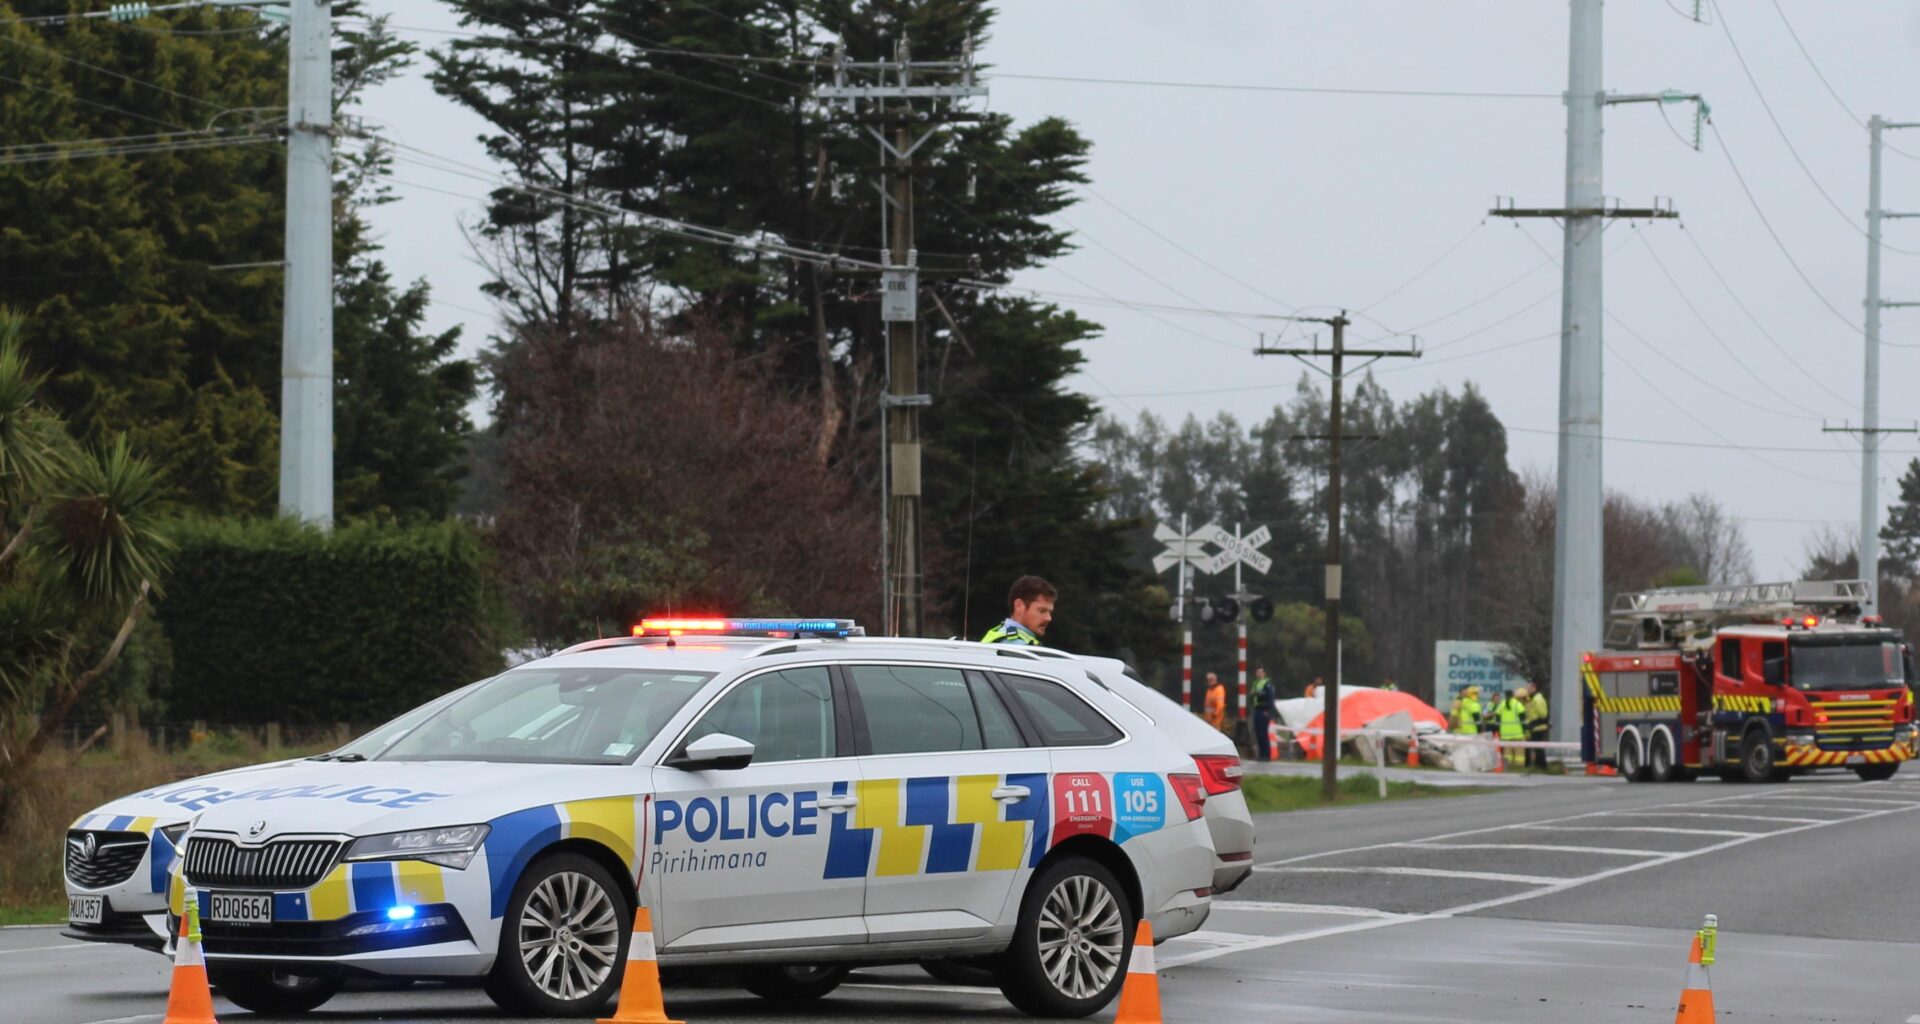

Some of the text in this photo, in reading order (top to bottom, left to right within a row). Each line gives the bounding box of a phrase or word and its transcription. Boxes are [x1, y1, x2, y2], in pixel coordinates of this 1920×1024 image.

[1215, 530, 1267, 569] CROSSING
[1449, 653, 1489, 667] Drive
[1448, 669, 1485, 681] cops
[1071, 778, 1092, 787] CALL
[1130, 778, 1144, 787] USE
[222, 784, 454, 808] POLICE
[1064, 790, 1102, 812] 111
[1122, 790, 1158, 812] 105
[654, 790, 818, 845] POLICE
[650, 849, 767, 874] Pirihimana
[212, 896, 270, 919] RDQ664
